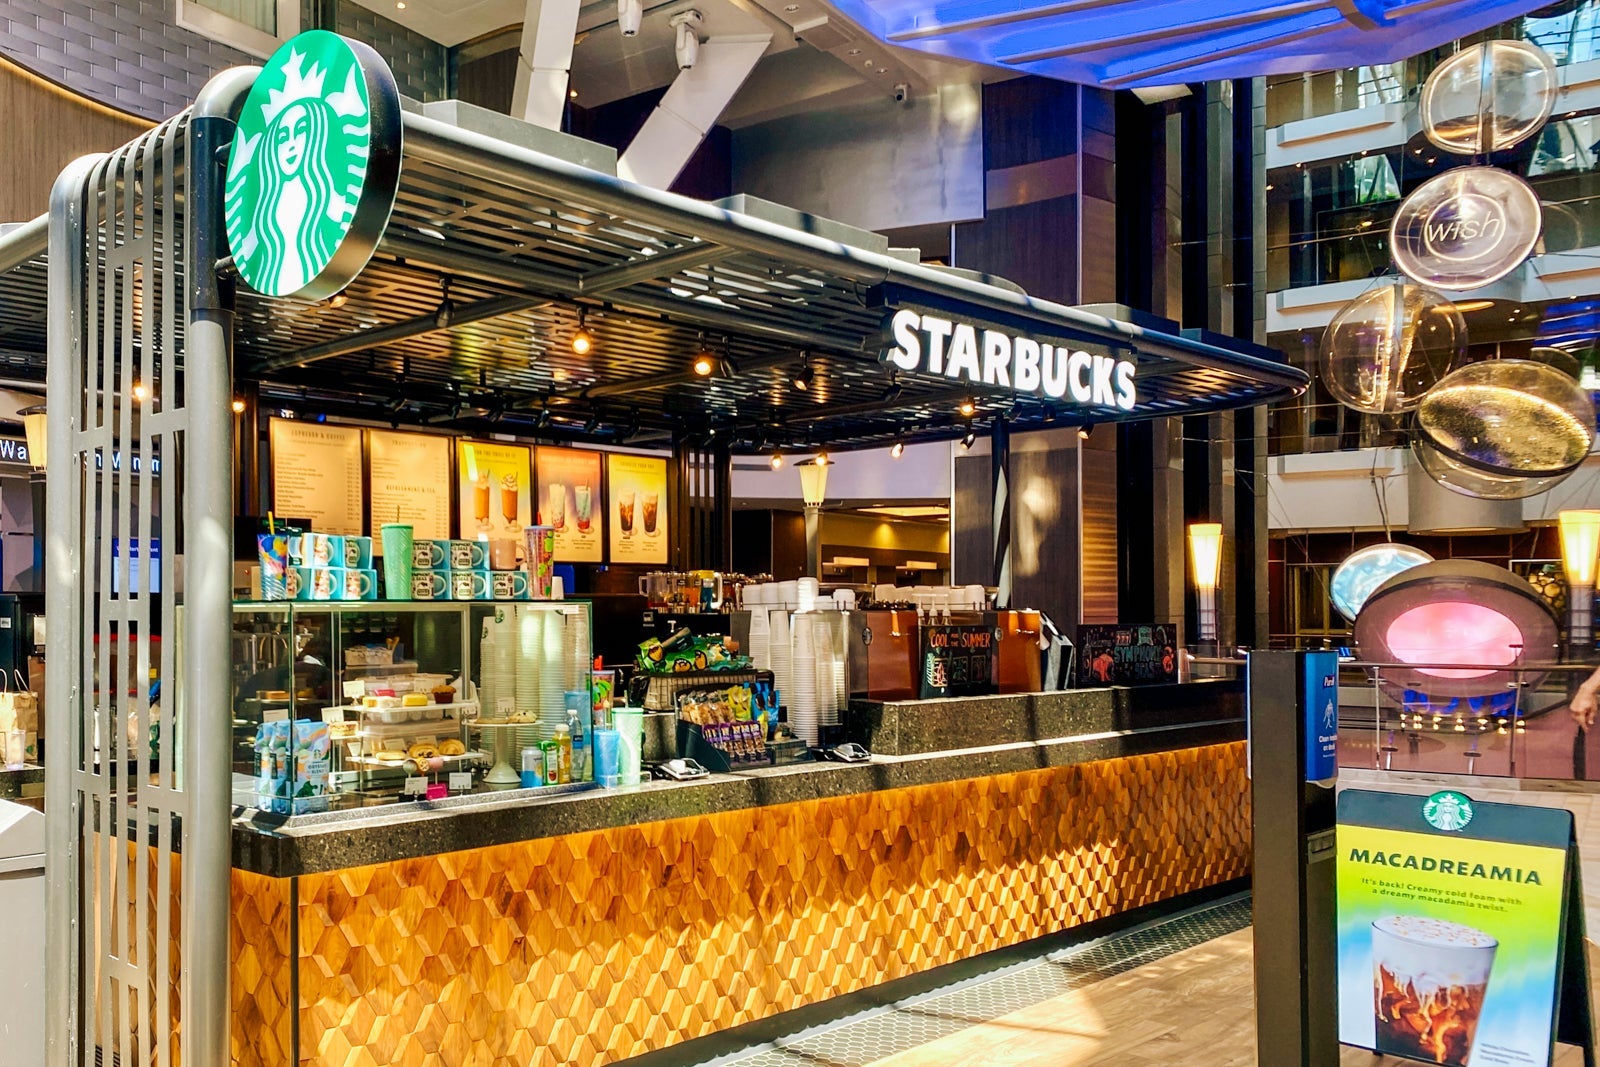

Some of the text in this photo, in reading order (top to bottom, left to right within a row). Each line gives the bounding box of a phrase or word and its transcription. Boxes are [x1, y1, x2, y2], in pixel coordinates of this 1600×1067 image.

[1428, 211, 1501, 242] wish
[890, 309, 1136, 411] STARBUCKS
[930, 633, 949, 648] COOL
[961, 632, 991, 648] SUMMER
[1349, 848, 1543, 886] MACADREAMIA
[1362, 877, 1523, 906] It's back! Creamy cold foam with
[1380, 888, 1417, 901] dreamy
[1418, 894, 1475, 908] macadamia
[1477, 903, 1509, 913] twist.
